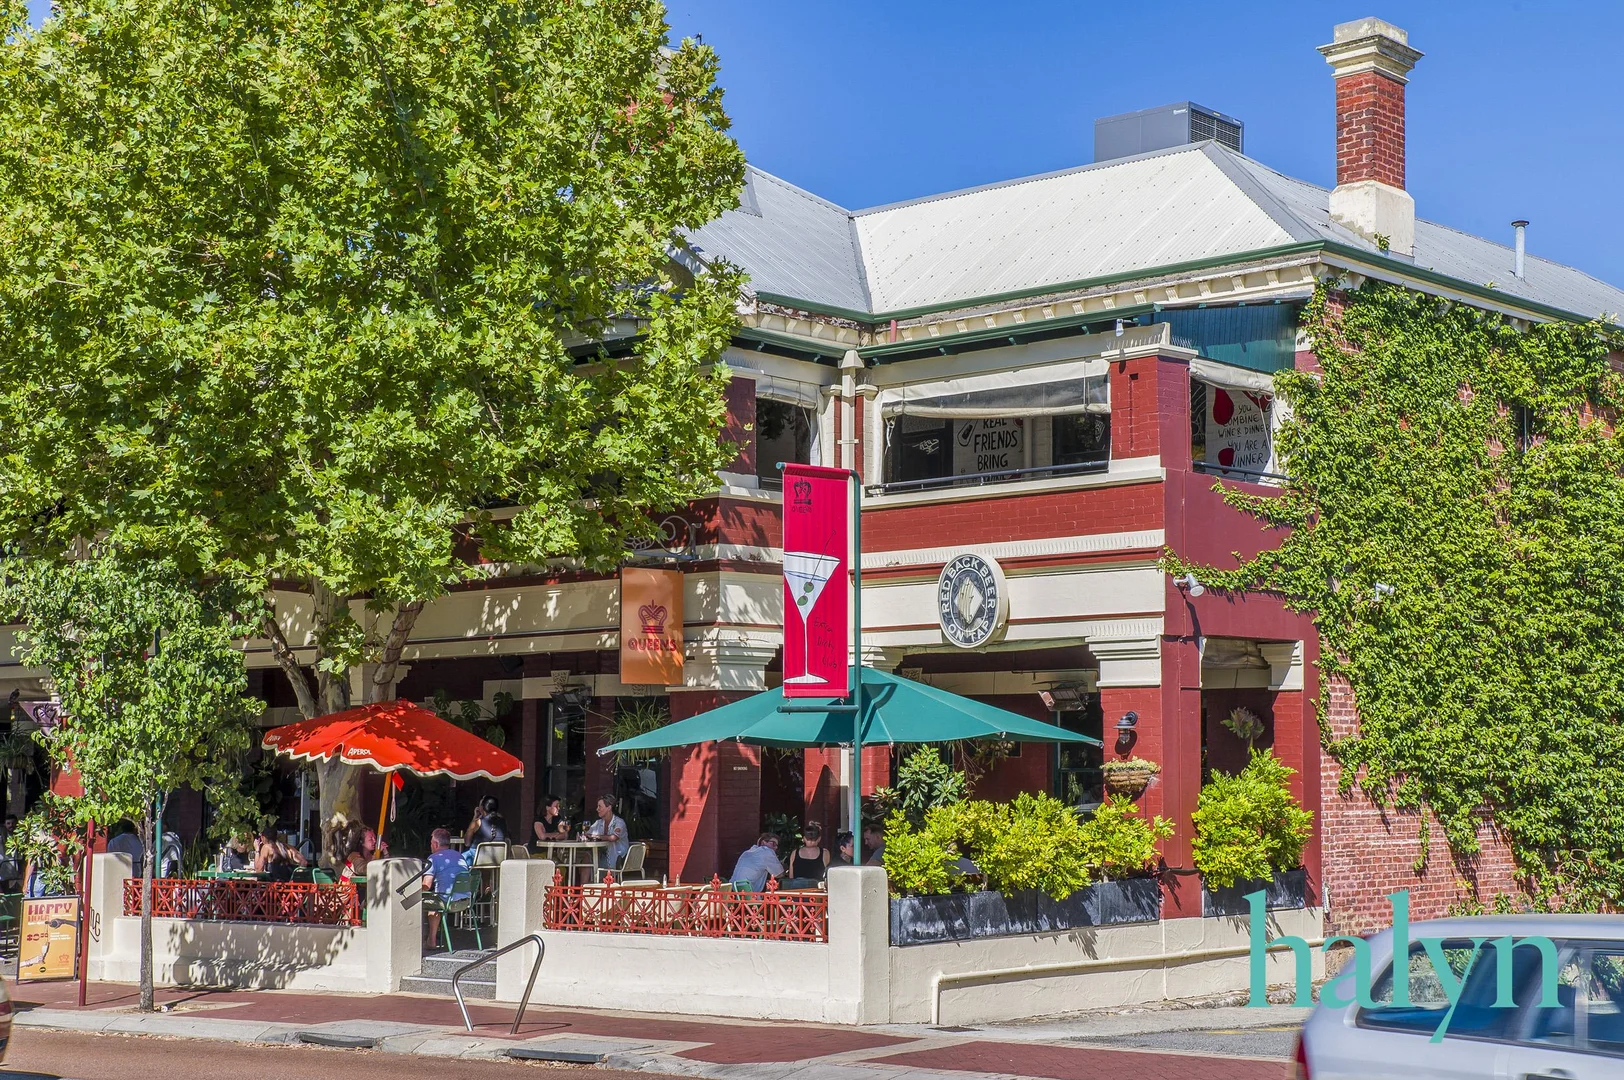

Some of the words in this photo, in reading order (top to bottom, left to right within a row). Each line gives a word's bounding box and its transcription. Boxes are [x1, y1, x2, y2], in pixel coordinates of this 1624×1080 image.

[1238, 404, 1252, 415] YOU
[983, 418, 1007, 429] REAL
[974, 430, 1017, 453] FRIENDS
[1244, 439, 1258, 450] ARE
[978, 453, 1007, 471] BRING
[941, 580, 951, 613] RED
[947, 557, 980, 579] BACK
[979, 564, 996, 609] BEER
[947, 623, 964, 642] ON
[969, 620, 990, 642] TAP
[628, 637, 677, 651] QUEENS
[347, 747, 372, 756] APEROL
[28, 903, 72, 915] HAPPY
